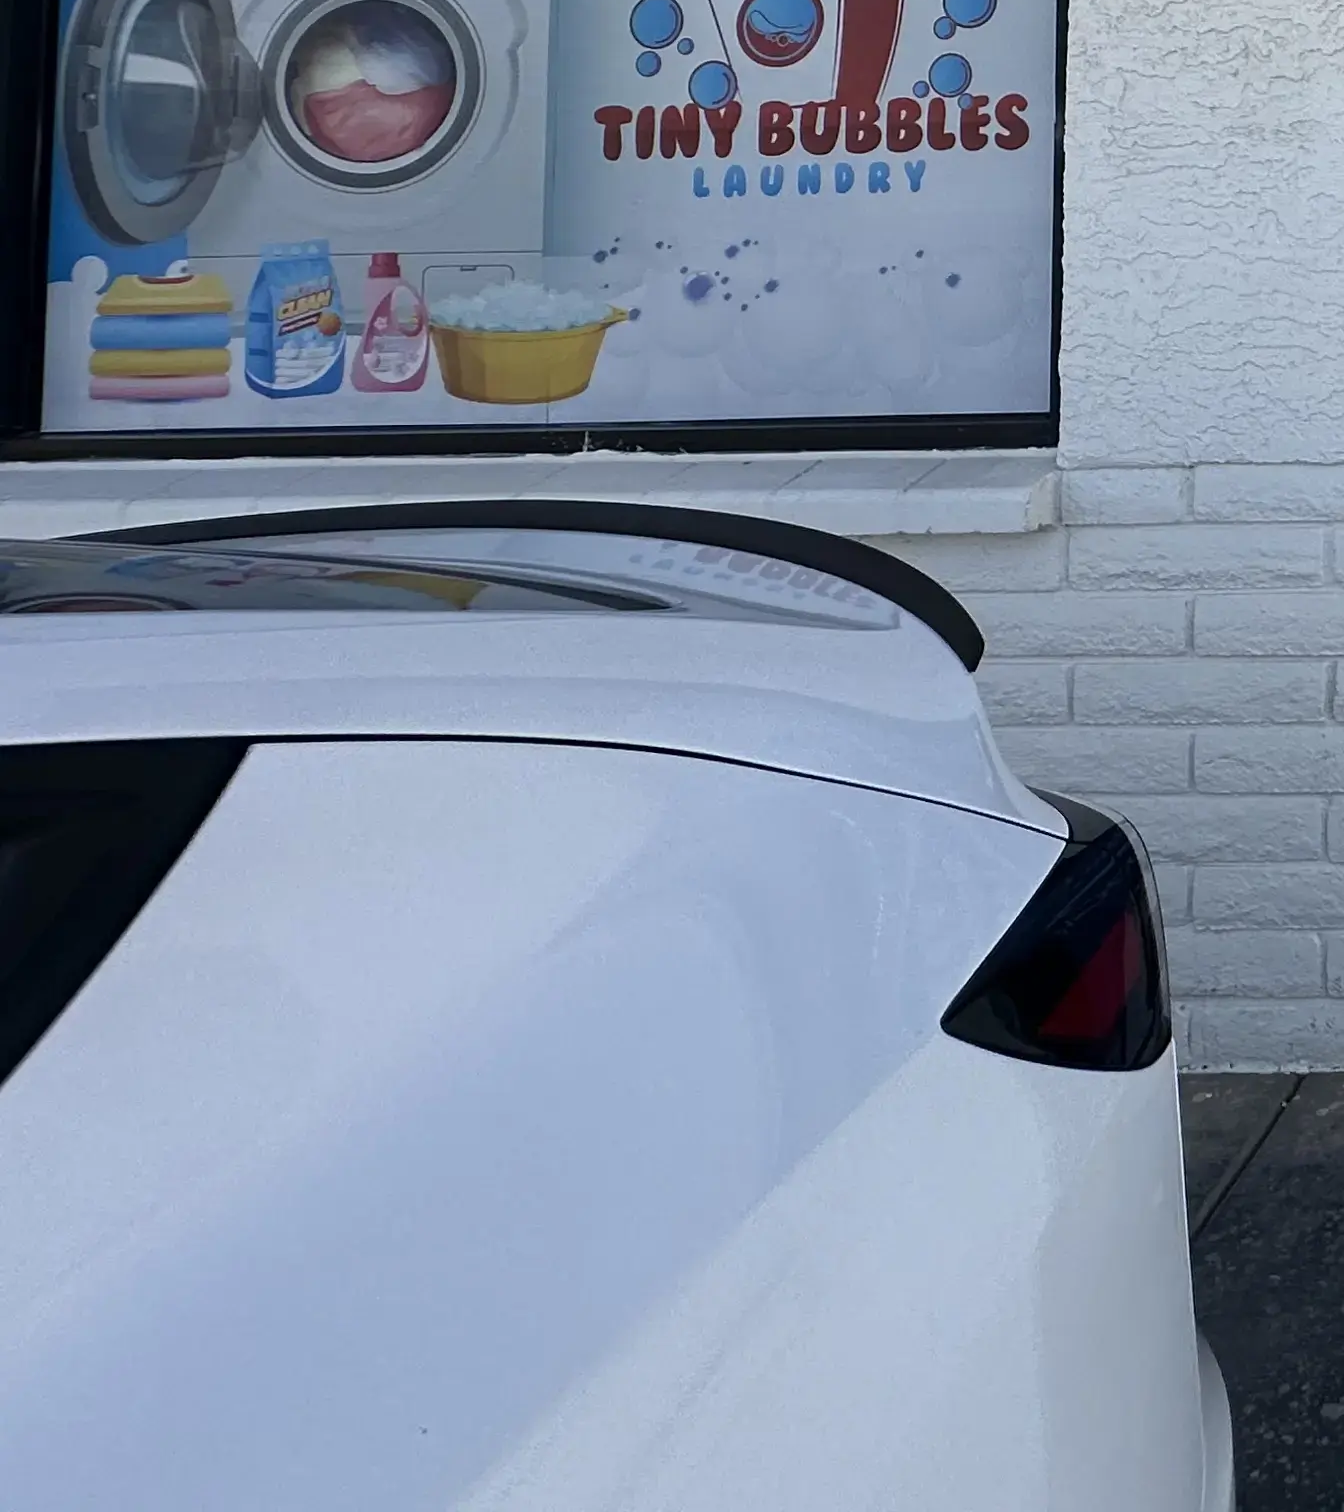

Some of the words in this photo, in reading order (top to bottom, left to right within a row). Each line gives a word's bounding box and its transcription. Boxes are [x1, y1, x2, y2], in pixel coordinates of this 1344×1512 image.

[594, 100, 742, 161] TINY
[758, 94, 1030, 156] BUBBLES
[693, 160, 926, 198] LAUNDRY
